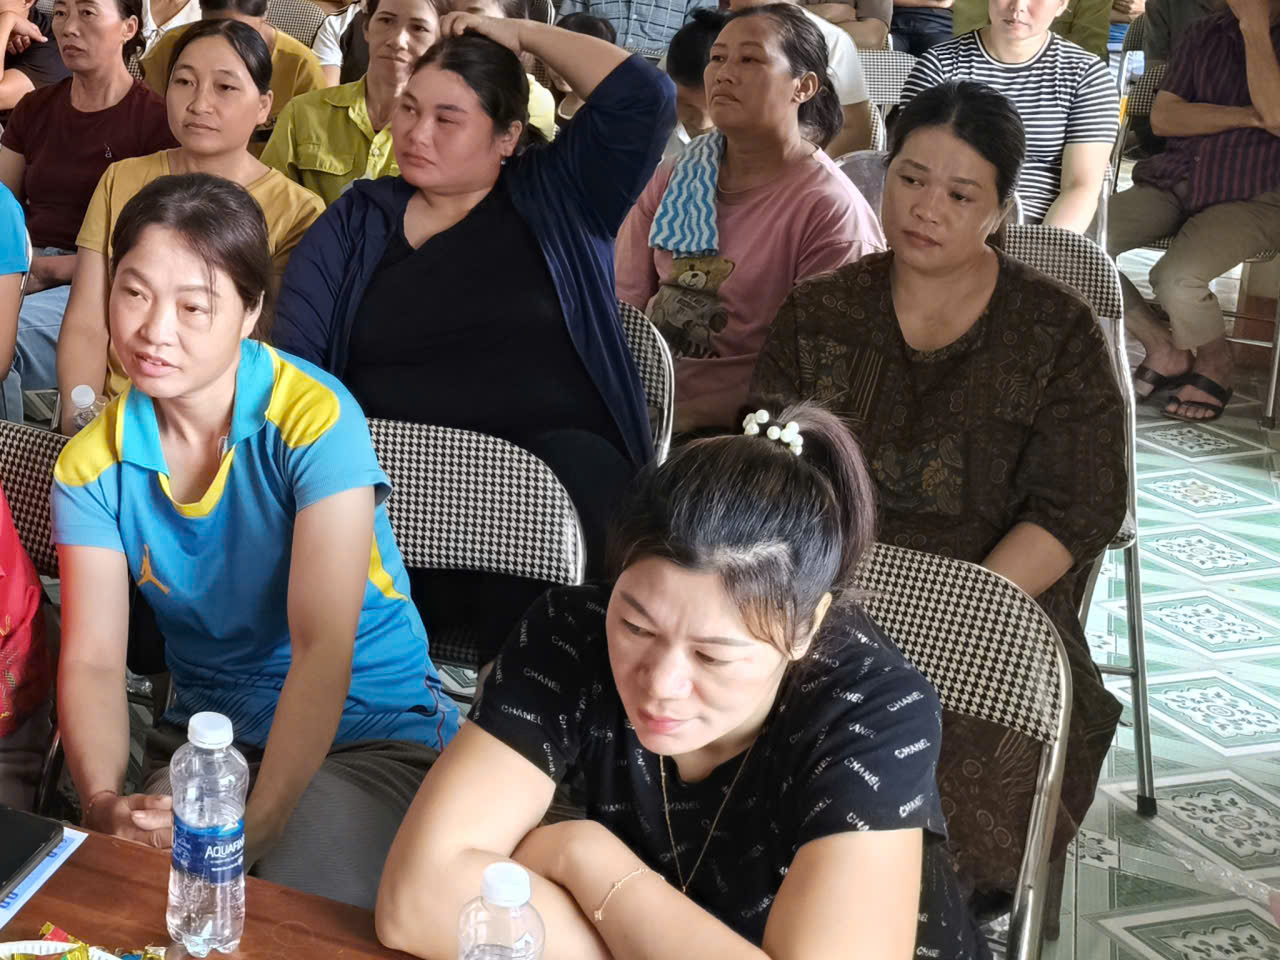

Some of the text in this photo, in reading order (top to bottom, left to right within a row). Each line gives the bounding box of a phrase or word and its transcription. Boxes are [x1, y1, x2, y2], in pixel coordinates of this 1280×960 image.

[886, 691, 925, 712] CHANEL
[501, 704, 544, 725] CHANEL
[894, 738, 931, 759] CHANEL
[843, 757, 883, 792] CHANEL
